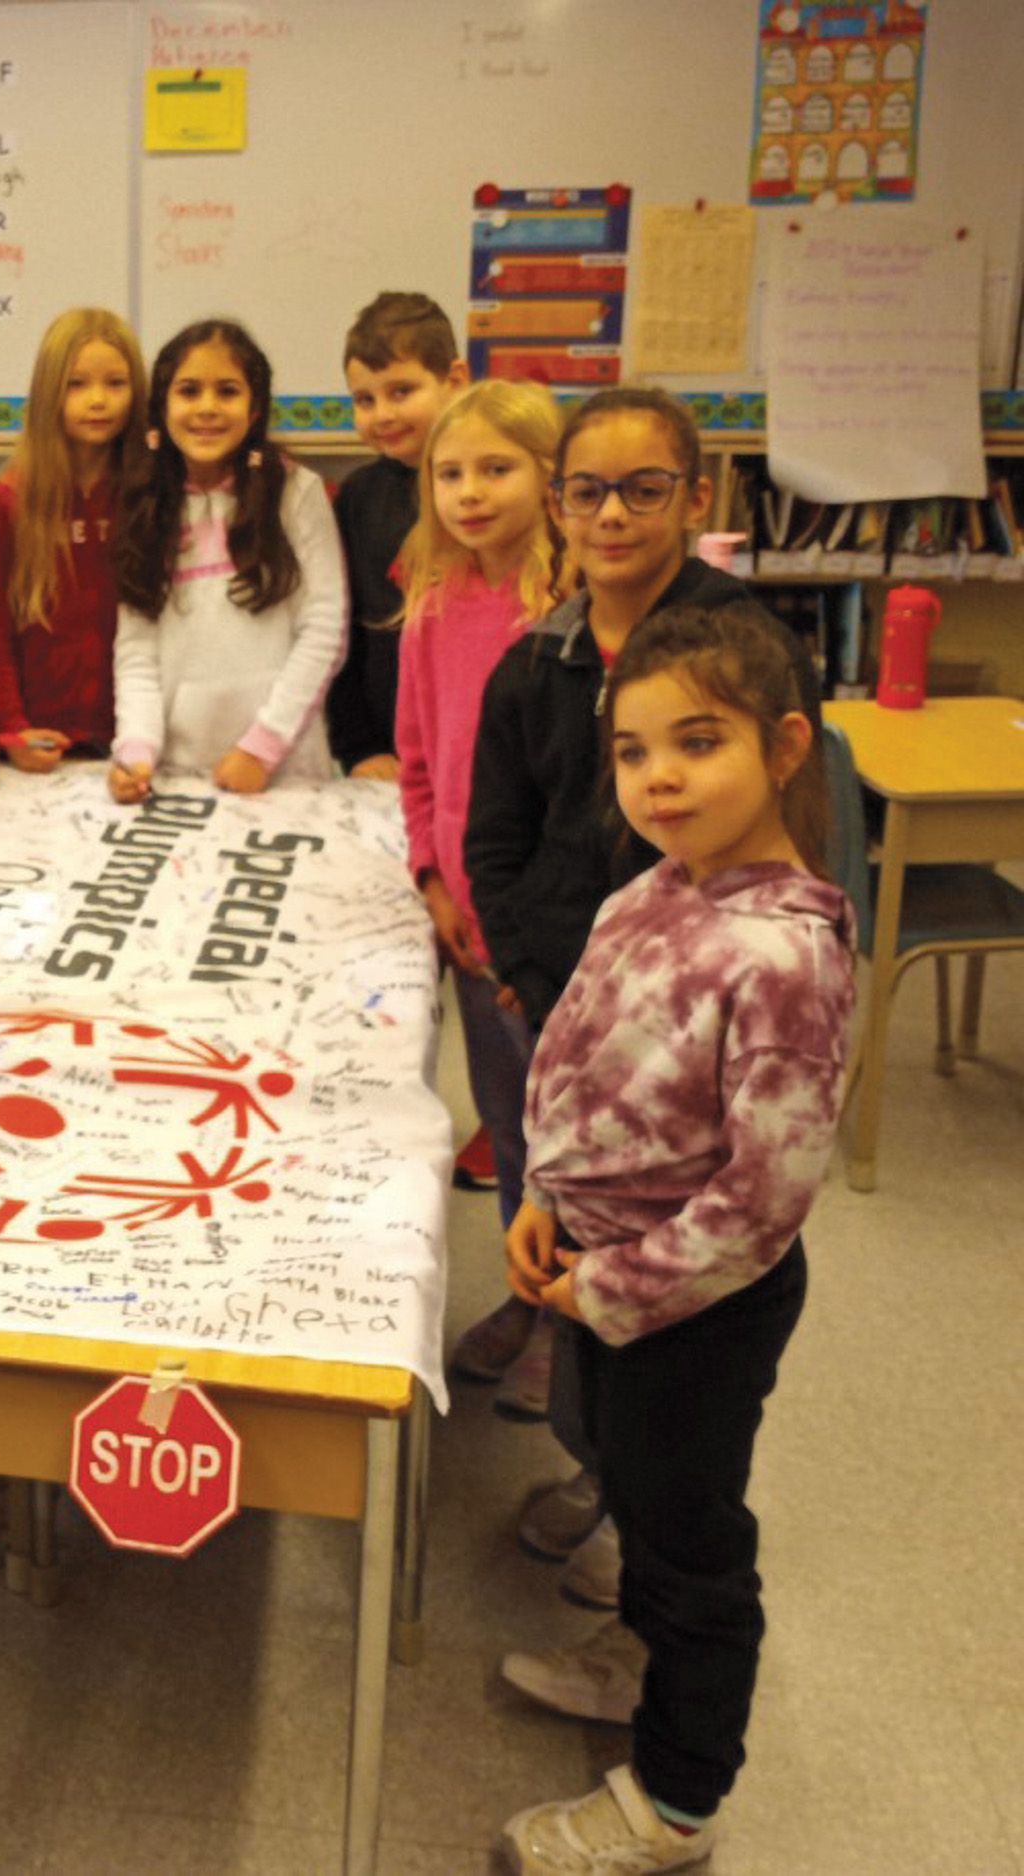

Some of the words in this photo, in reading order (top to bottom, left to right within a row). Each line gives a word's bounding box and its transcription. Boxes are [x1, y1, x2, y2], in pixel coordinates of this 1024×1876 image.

[43, 795, 217, 981] Olympics
[189, 829, 324, 984] Special
[89, 1429, 221, 1496] STOP
